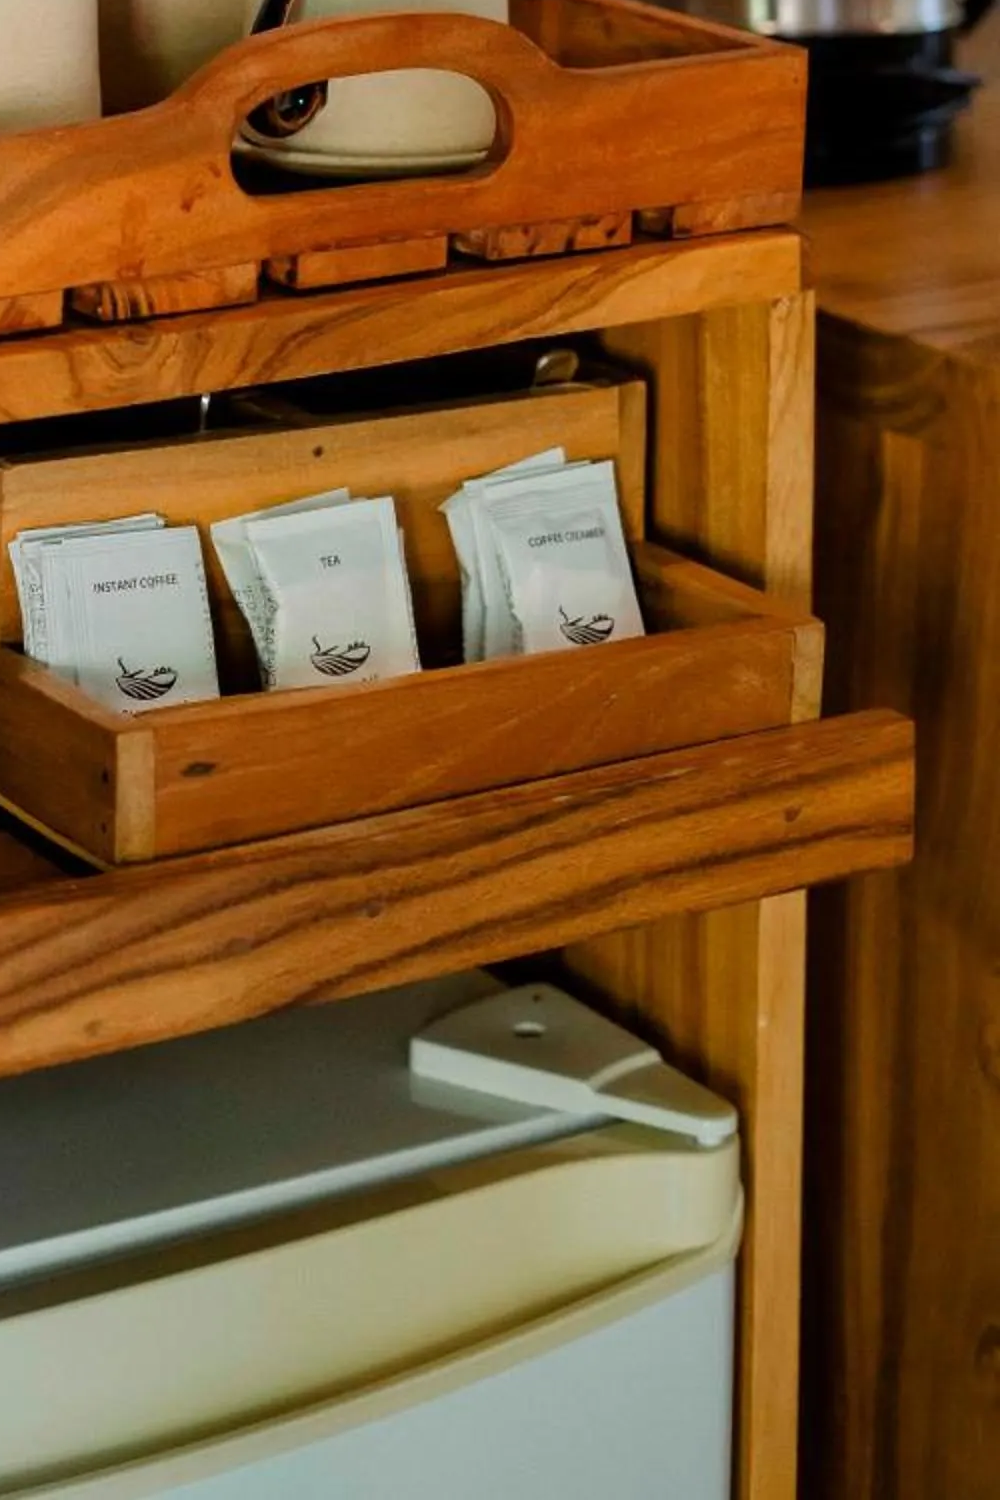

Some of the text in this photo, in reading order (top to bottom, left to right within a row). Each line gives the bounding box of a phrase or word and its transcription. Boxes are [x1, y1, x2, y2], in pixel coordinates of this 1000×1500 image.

[528, 531, 563, 548] COFFEE
[319, 555, 341, 570] TEA
[92, 573, 178, 593] INSTANT COFFEE
